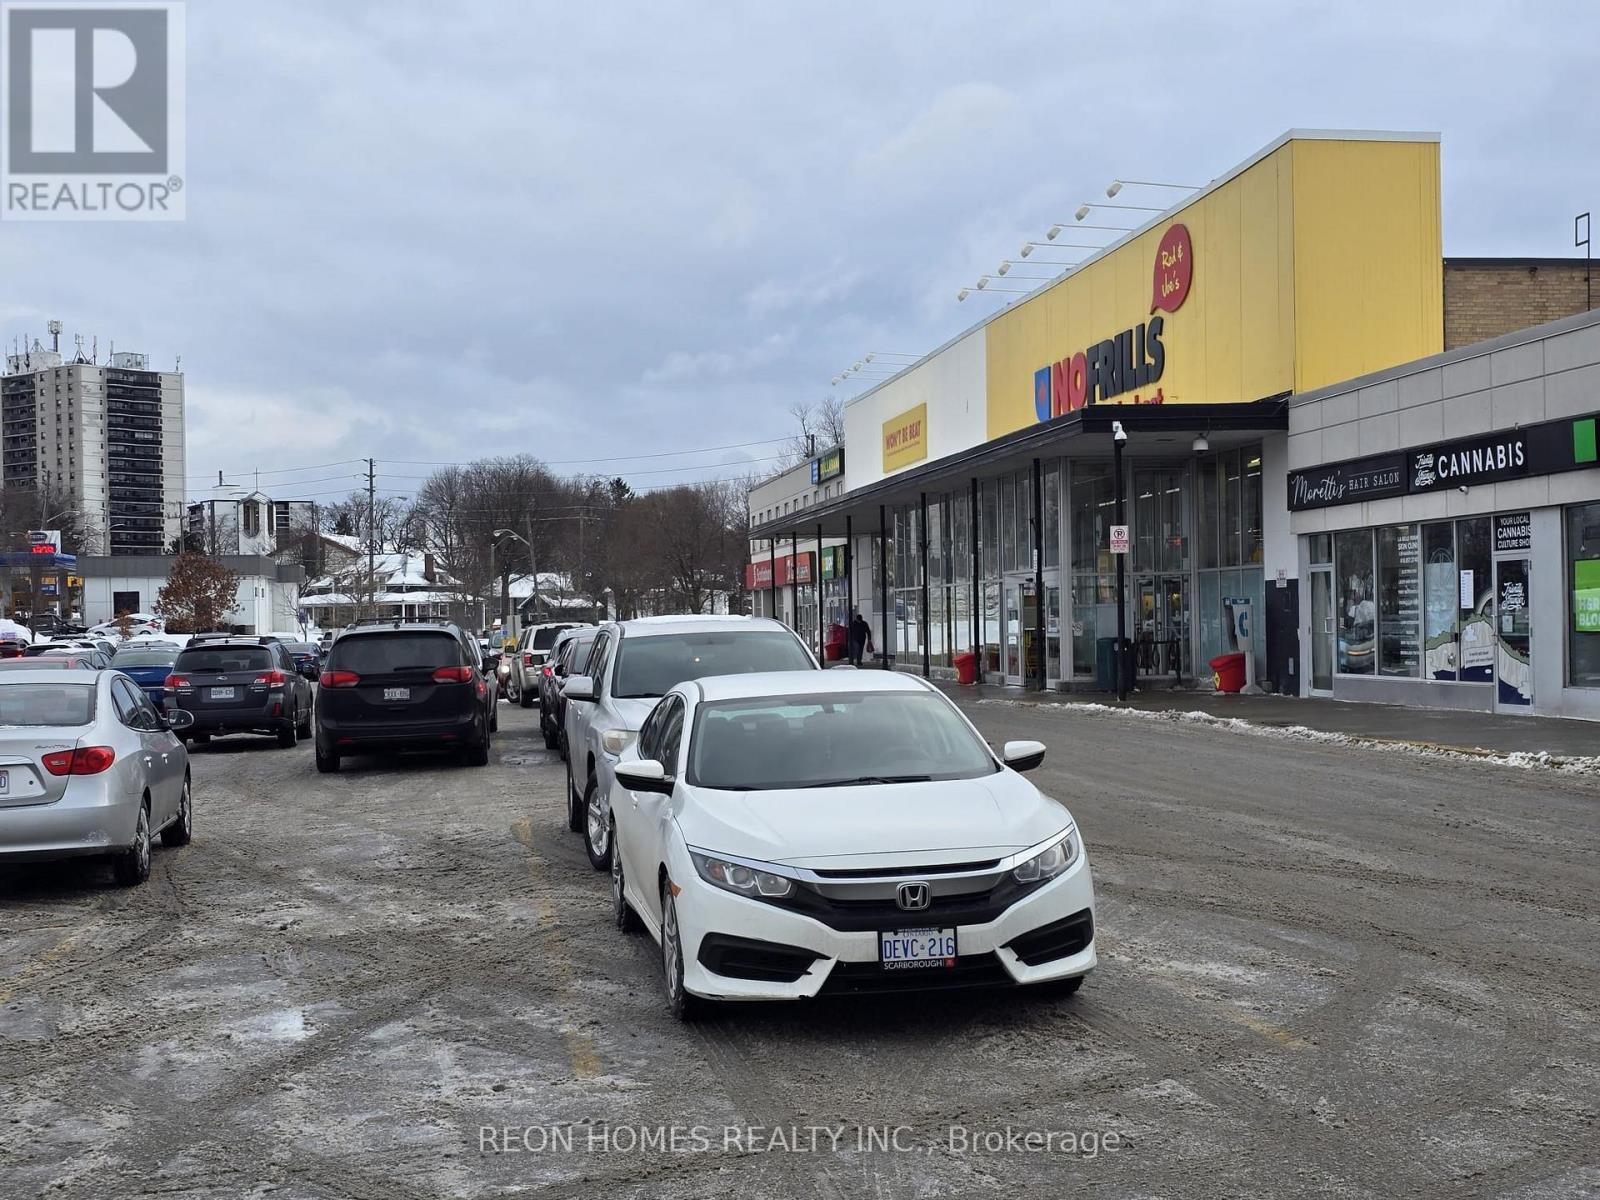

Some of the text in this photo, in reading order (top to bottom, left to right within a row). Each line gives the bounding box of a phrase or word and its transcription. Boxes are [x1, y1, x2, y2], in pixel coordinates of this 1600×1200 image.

[1438, 441, 1524, 478] CANNABIS
[1291, 469, 1347, 505] Moretti's
[1348, 477, 1369, 490] HAIR
[1373, 471, 1400, 487] SALON
[1513, 515, 1530, 525] LOCAL
[1497, 525, 1531, 539] CANNABIS
[1518, 538, 1531, 547] SHO
[883, 959, 943, 970] SCARBOROUGH
